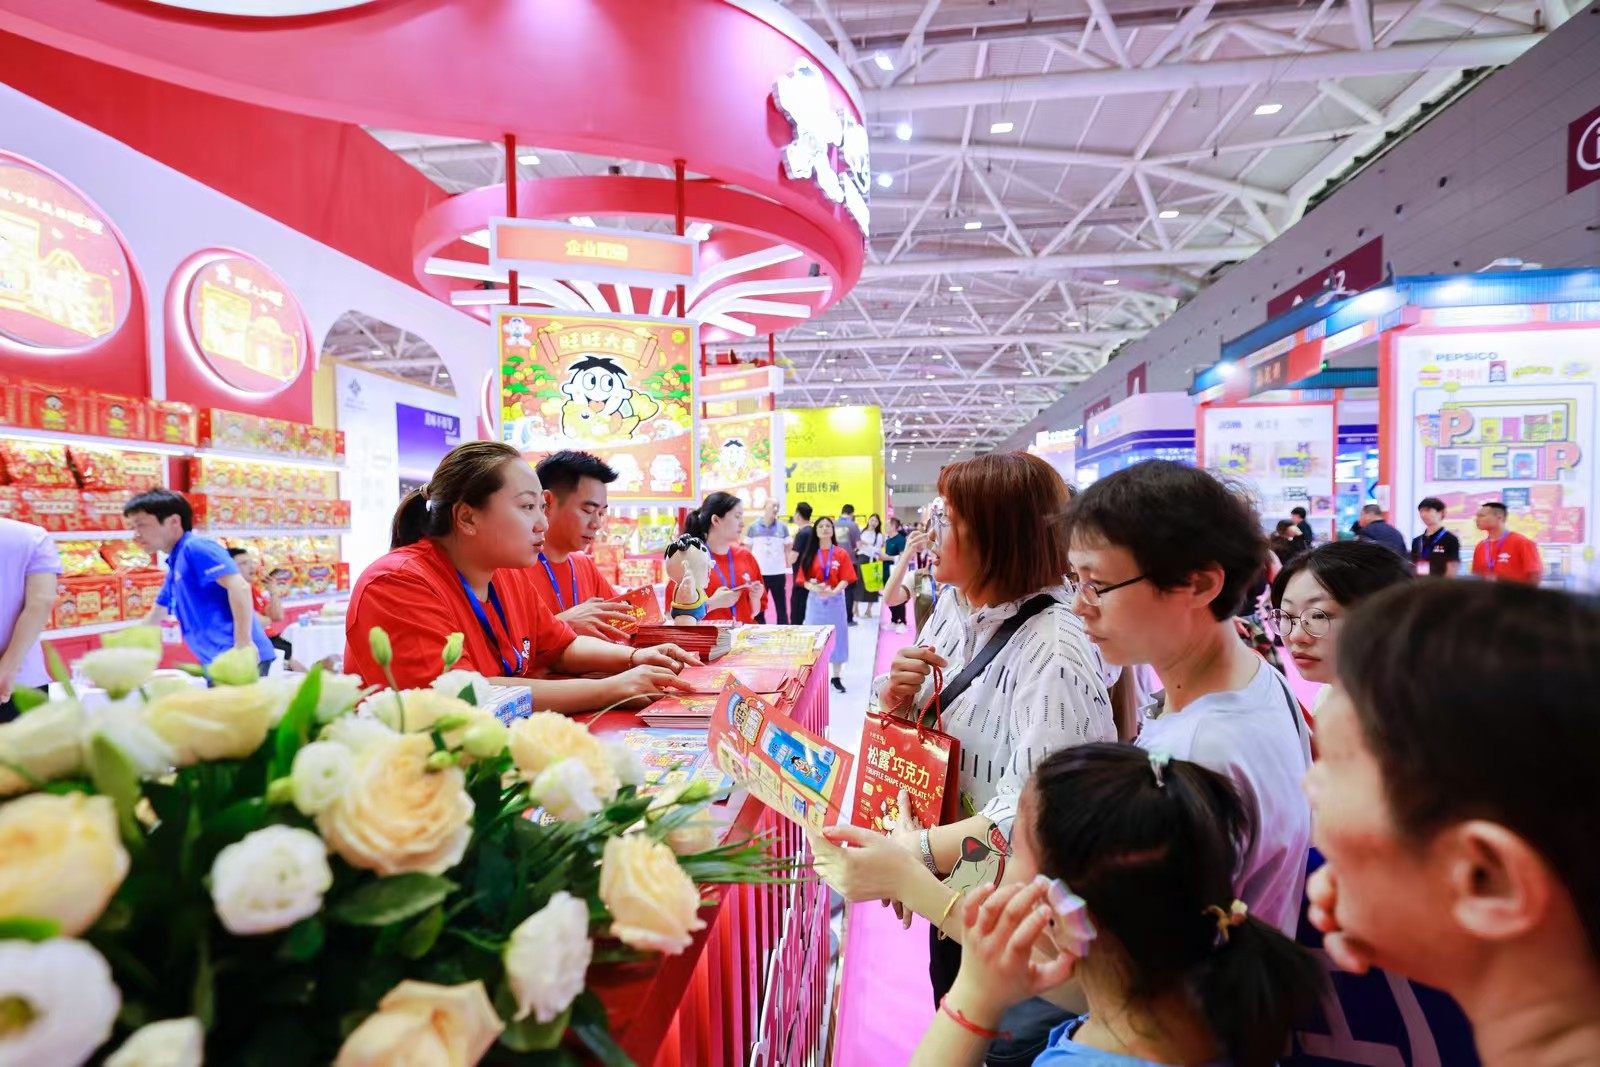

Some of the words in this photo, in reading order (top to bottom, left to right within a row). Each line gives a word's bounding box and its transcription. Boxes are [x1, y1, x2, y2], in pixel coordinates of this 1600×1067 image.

[1436, 352, 1498, 361] PEPSICO
[796, 482, 839, 493] 匠心传承
[867, 744, 930, 789] 松露巧克力
[865, 766, 884, 780] TRUFFLE
[884, 774, 899, 787] SHAPE
[899, 781, 927, 800] CHOCOLATE
